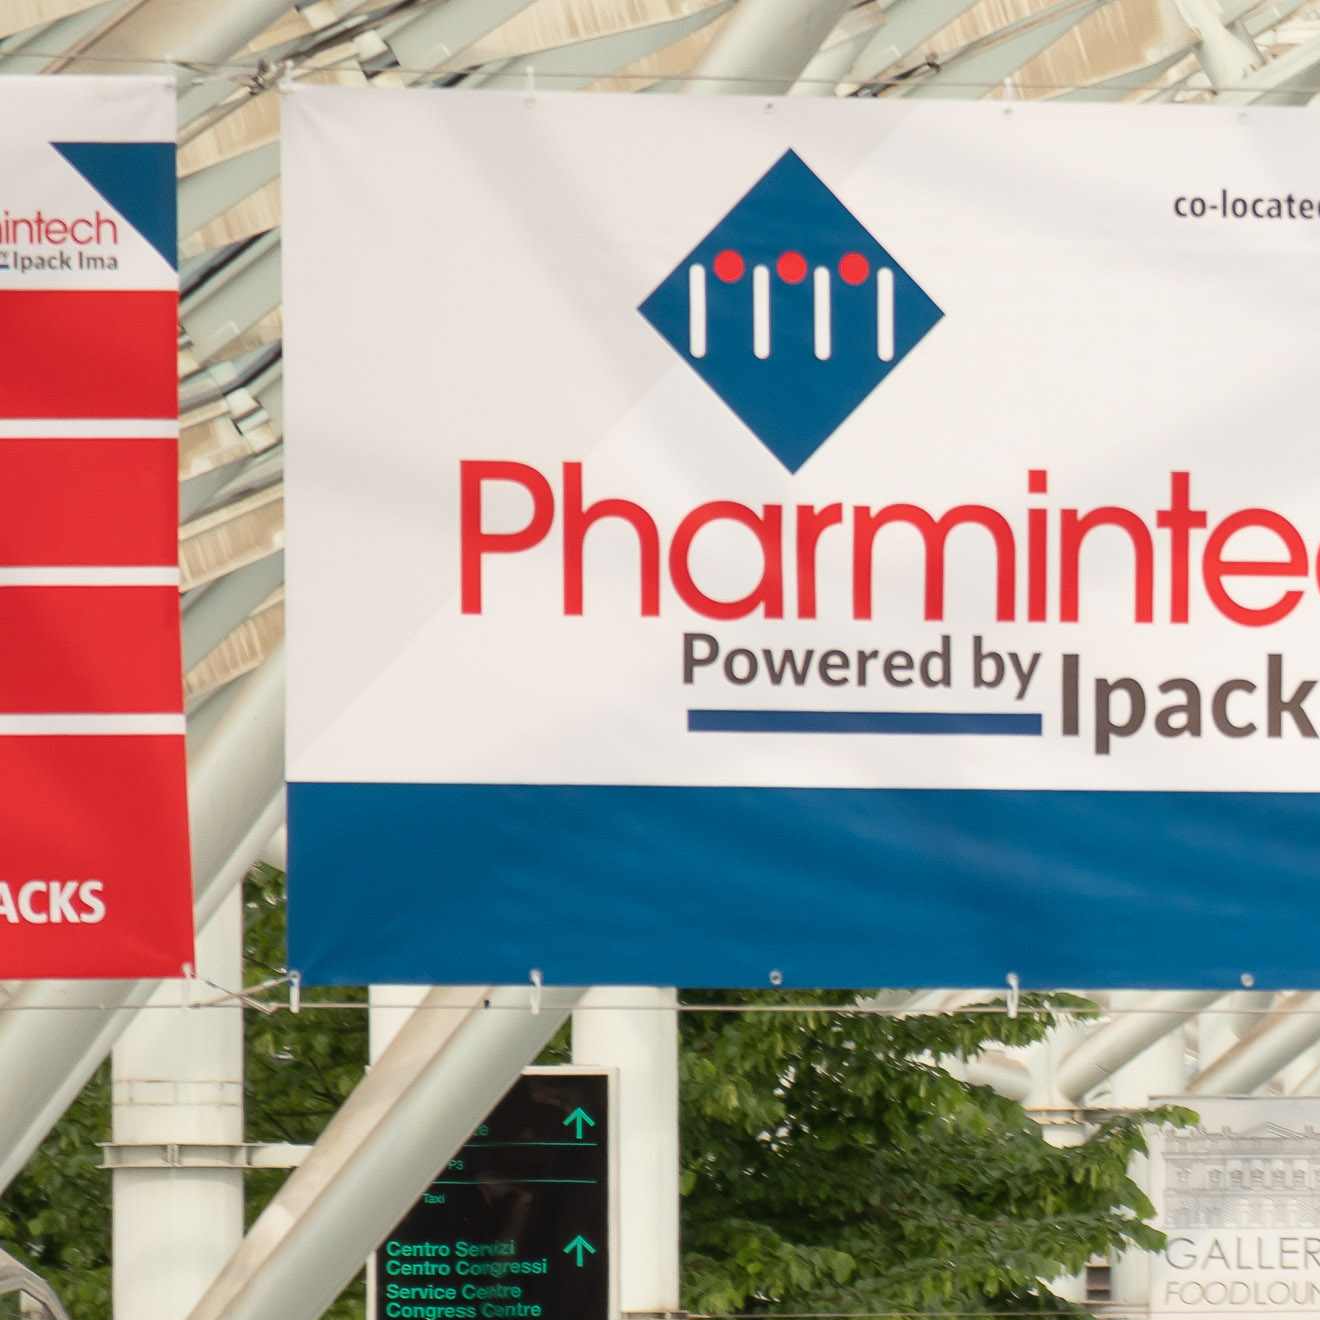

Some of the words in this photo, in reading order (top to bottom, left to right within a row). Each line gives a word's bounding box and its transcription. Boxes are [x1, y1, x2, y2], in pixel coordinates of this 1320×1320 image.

[0, 209, 118, 245] intech
[13, 250, 72, 274] Ipack
[79, 251, 118, 270] Ima
[682, 632, 953, 689] Powered
[971, 636, 1042, 700] by
[1061, 652, 1319, 756] Ipack
[423, 1193, 445, 1204] Taxi
[386, 1241, 449, 1257] Centro
[455, 1240, 516, 1257] Servizi
[386, 1260, 450, 1276] Centro
[455, 1258, 548, 1278] Congressi
[386, 1284, 457, 1300] Service
[462, 1284, 522, 1300] Centre
[386, 1302, 477, 1320] Congress
[481, 1303, 542, 1318] Centre
